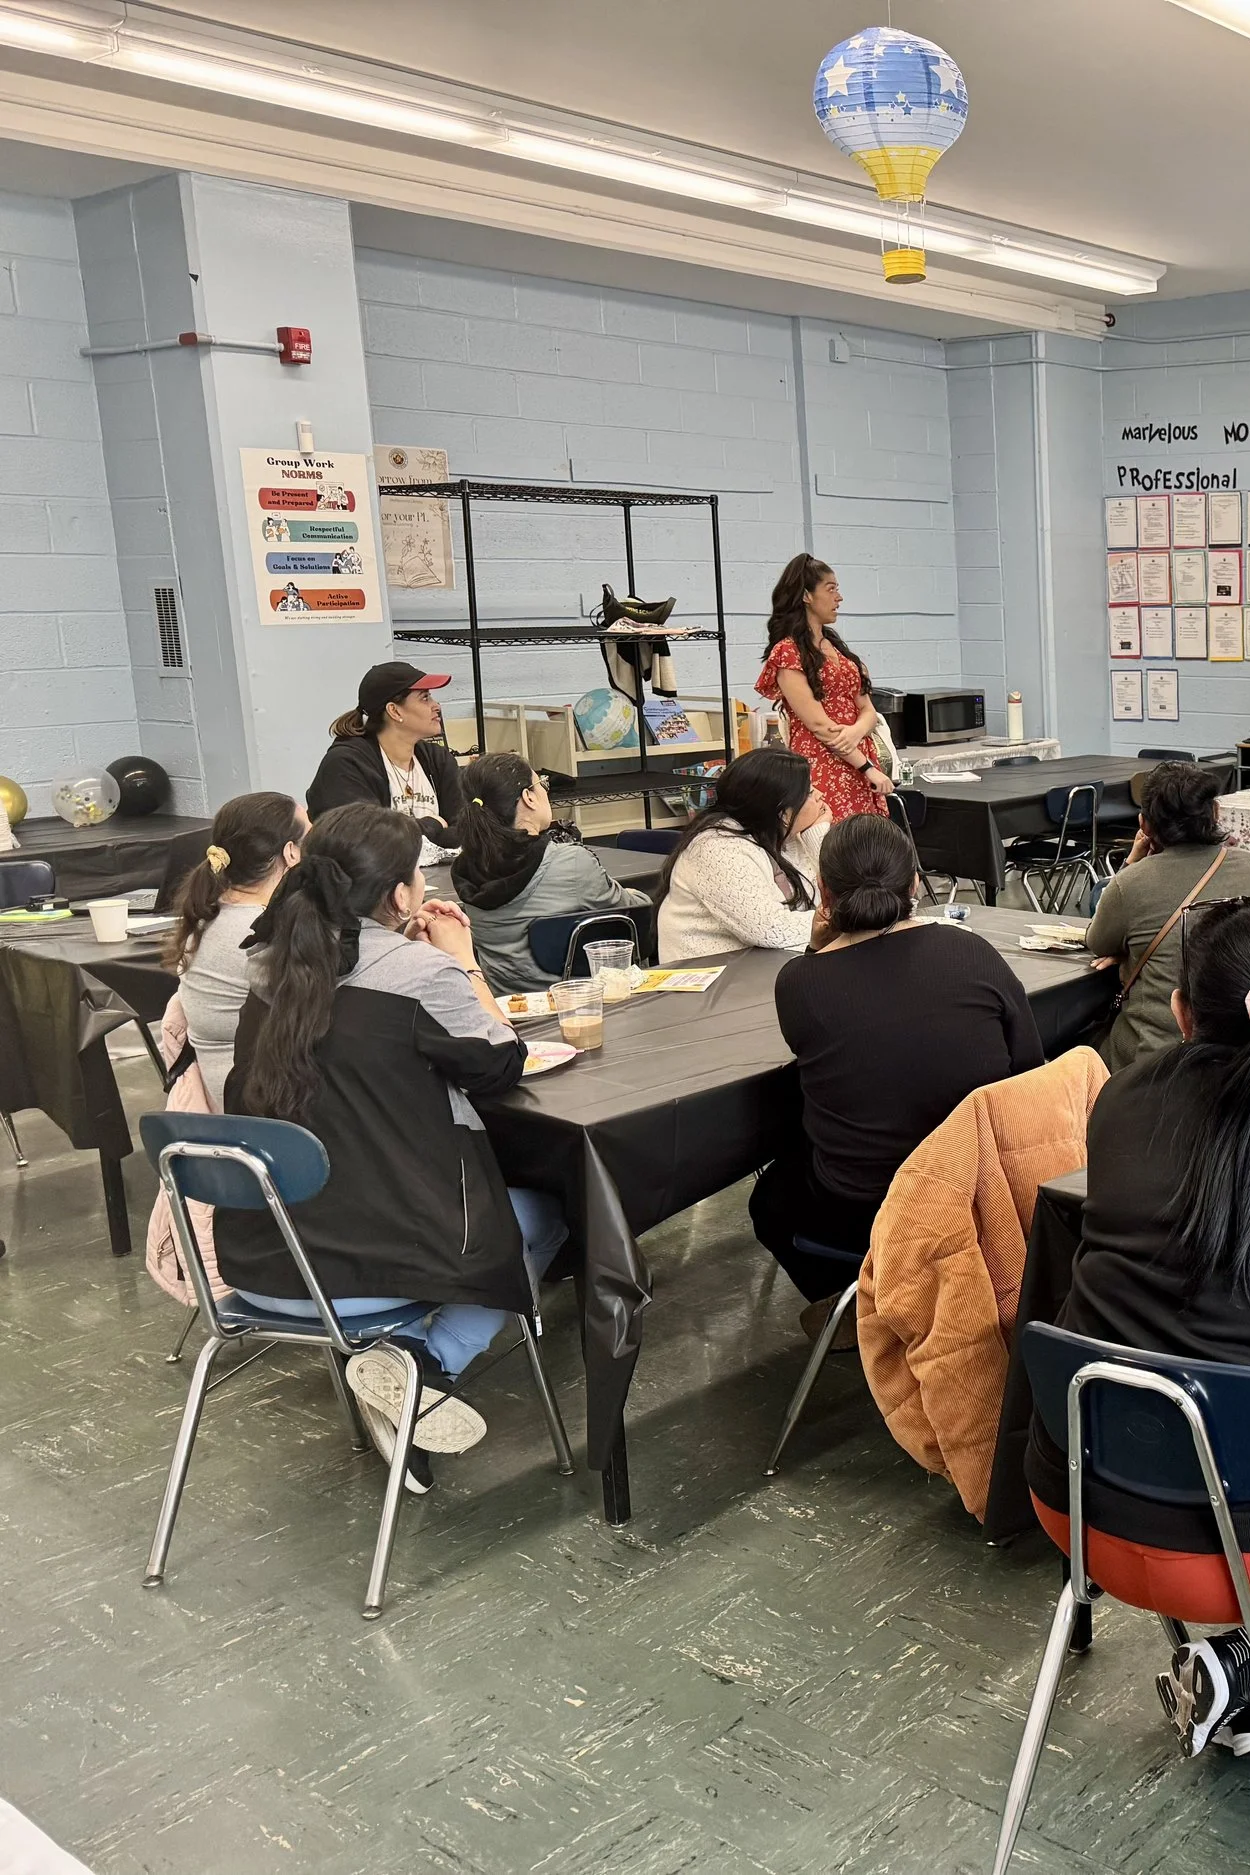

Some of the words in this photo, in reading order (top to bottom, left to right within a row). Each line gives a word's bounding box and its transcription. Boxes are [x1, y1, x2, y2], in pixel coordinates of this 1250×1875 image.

[294, 342, 311, 351] FIRE
[266, 456, 300, 468] Group
[303, 459, 335, 469] Work
[281, 469, 323, 480] NORMS
[282, 499, 314, 507] Prepared
[393, 513, 415, 523] your
[309, 525, 345, 534] Respectful
[316, 600, 360, 608] Participation
